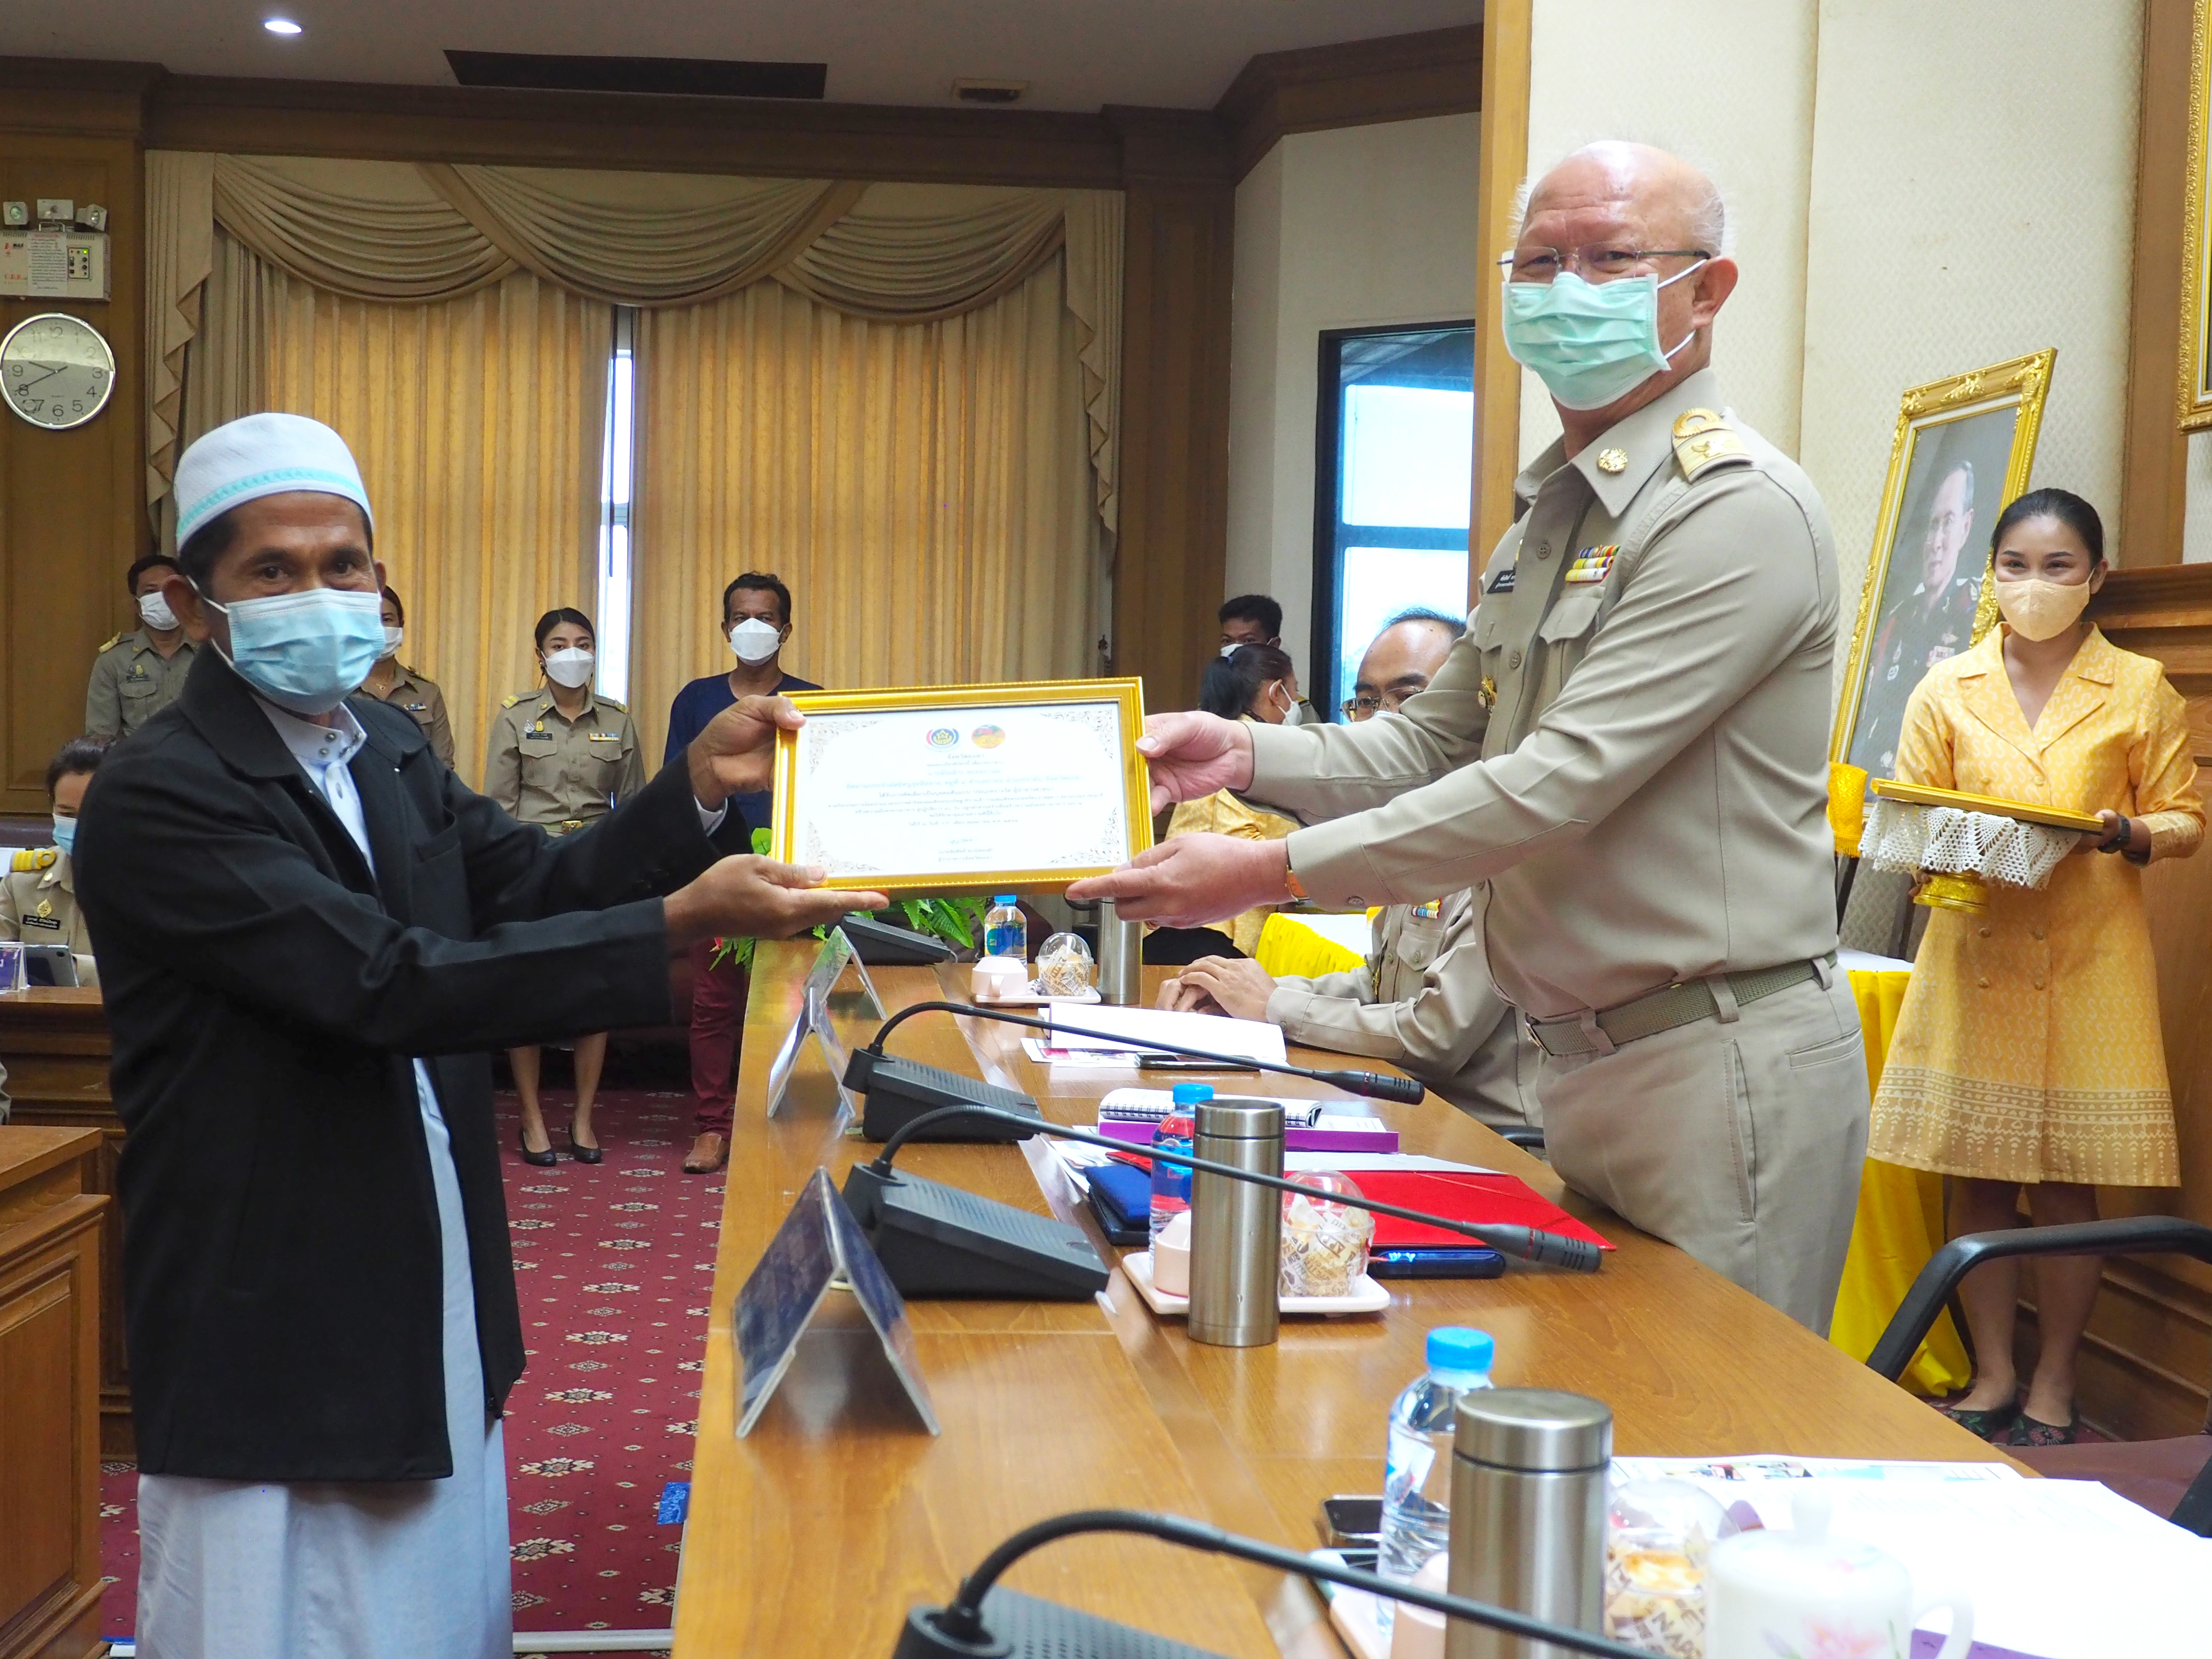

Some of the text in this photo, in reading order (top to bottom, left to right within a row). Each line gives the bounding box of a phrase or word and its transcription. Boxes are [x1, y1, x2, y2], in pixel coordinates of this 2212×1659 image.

[86, 346, 96, 358] 2
[12, 364, 23, 376] 9
[92, 367, 103, 379] 3
[18, 384, 29, 396] 8
[86, 386, 97, 398] 4
[52, 405, 63, 416] 6
[72, 400, 83, 412] 5
